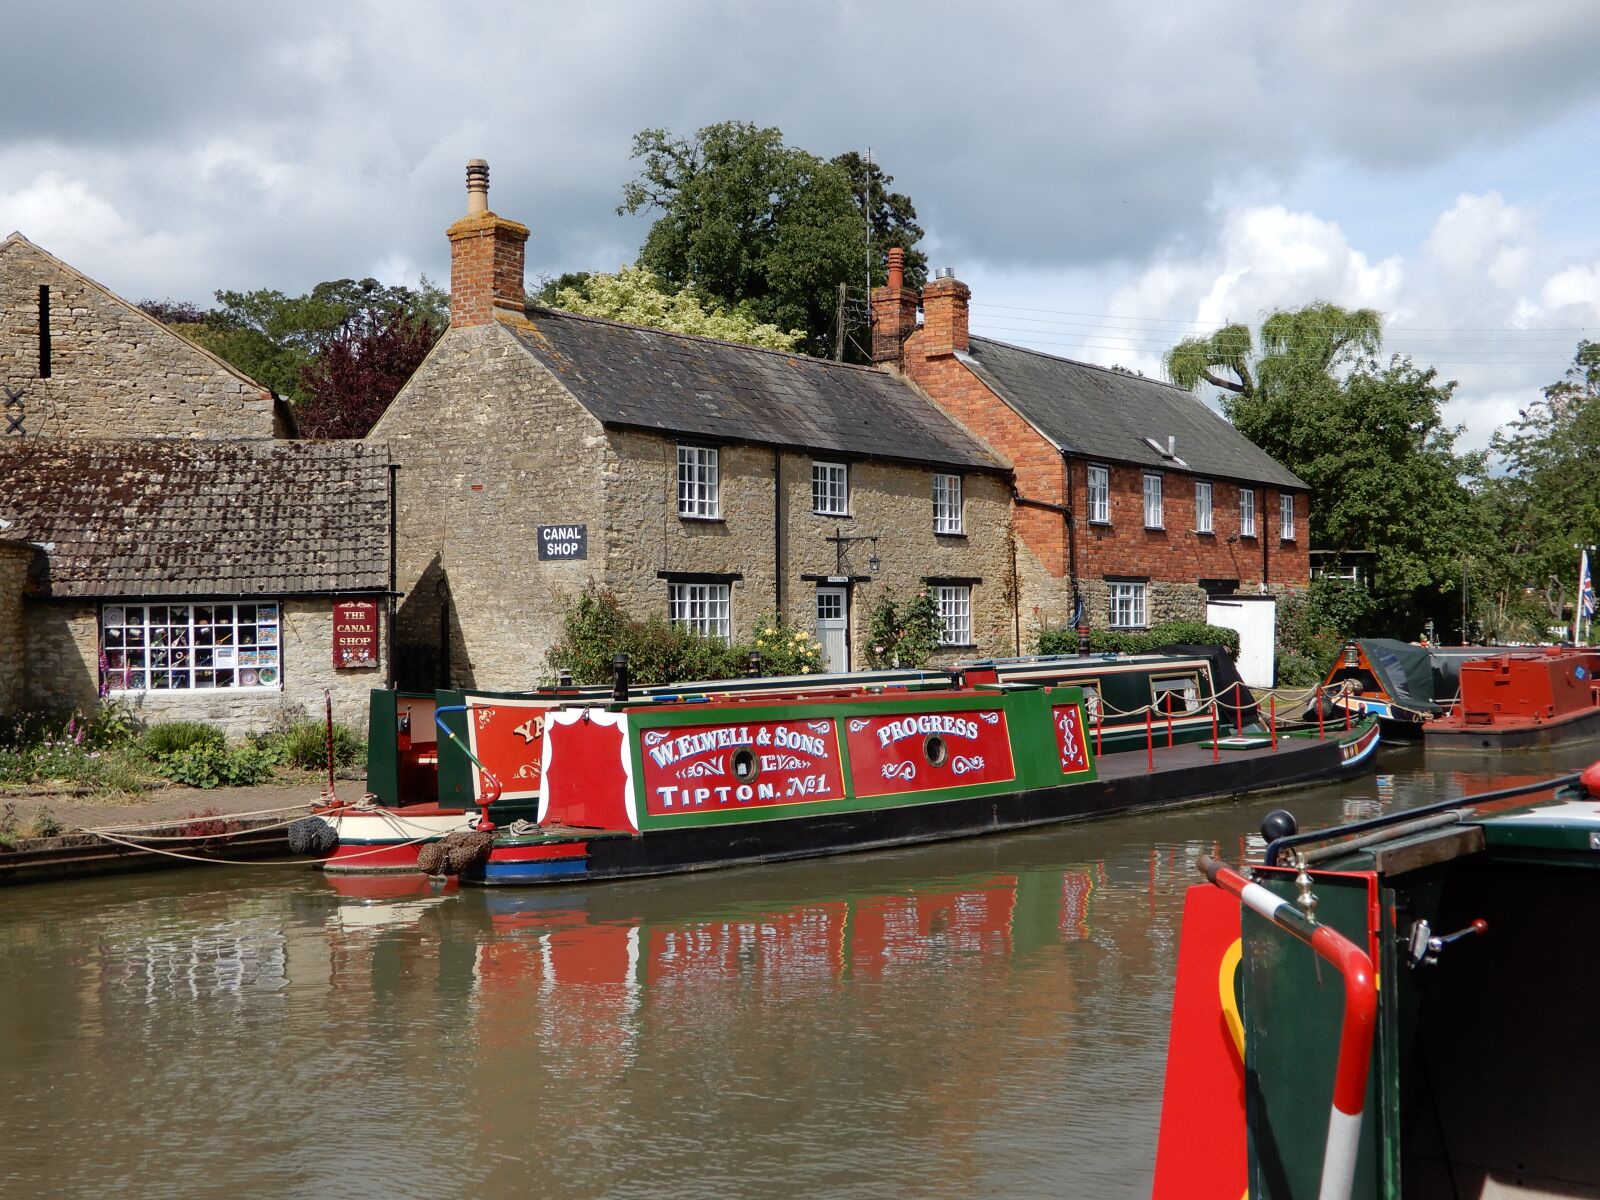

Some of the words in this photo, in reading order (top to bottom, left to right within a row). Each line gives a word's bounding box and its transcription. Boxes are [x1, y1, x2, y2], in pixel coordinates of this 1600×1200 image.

[543, 527, 582, 541] CANAL
[547, 542, 578, 556] SHOP
[344, 611, 366, 620] THE
[337, 624, 374, 633] CANAL
[339, 637, 371, 646] SHOP
[756, 726, 772, 746] &
[876, 715, 978, 748] PROGRESS
